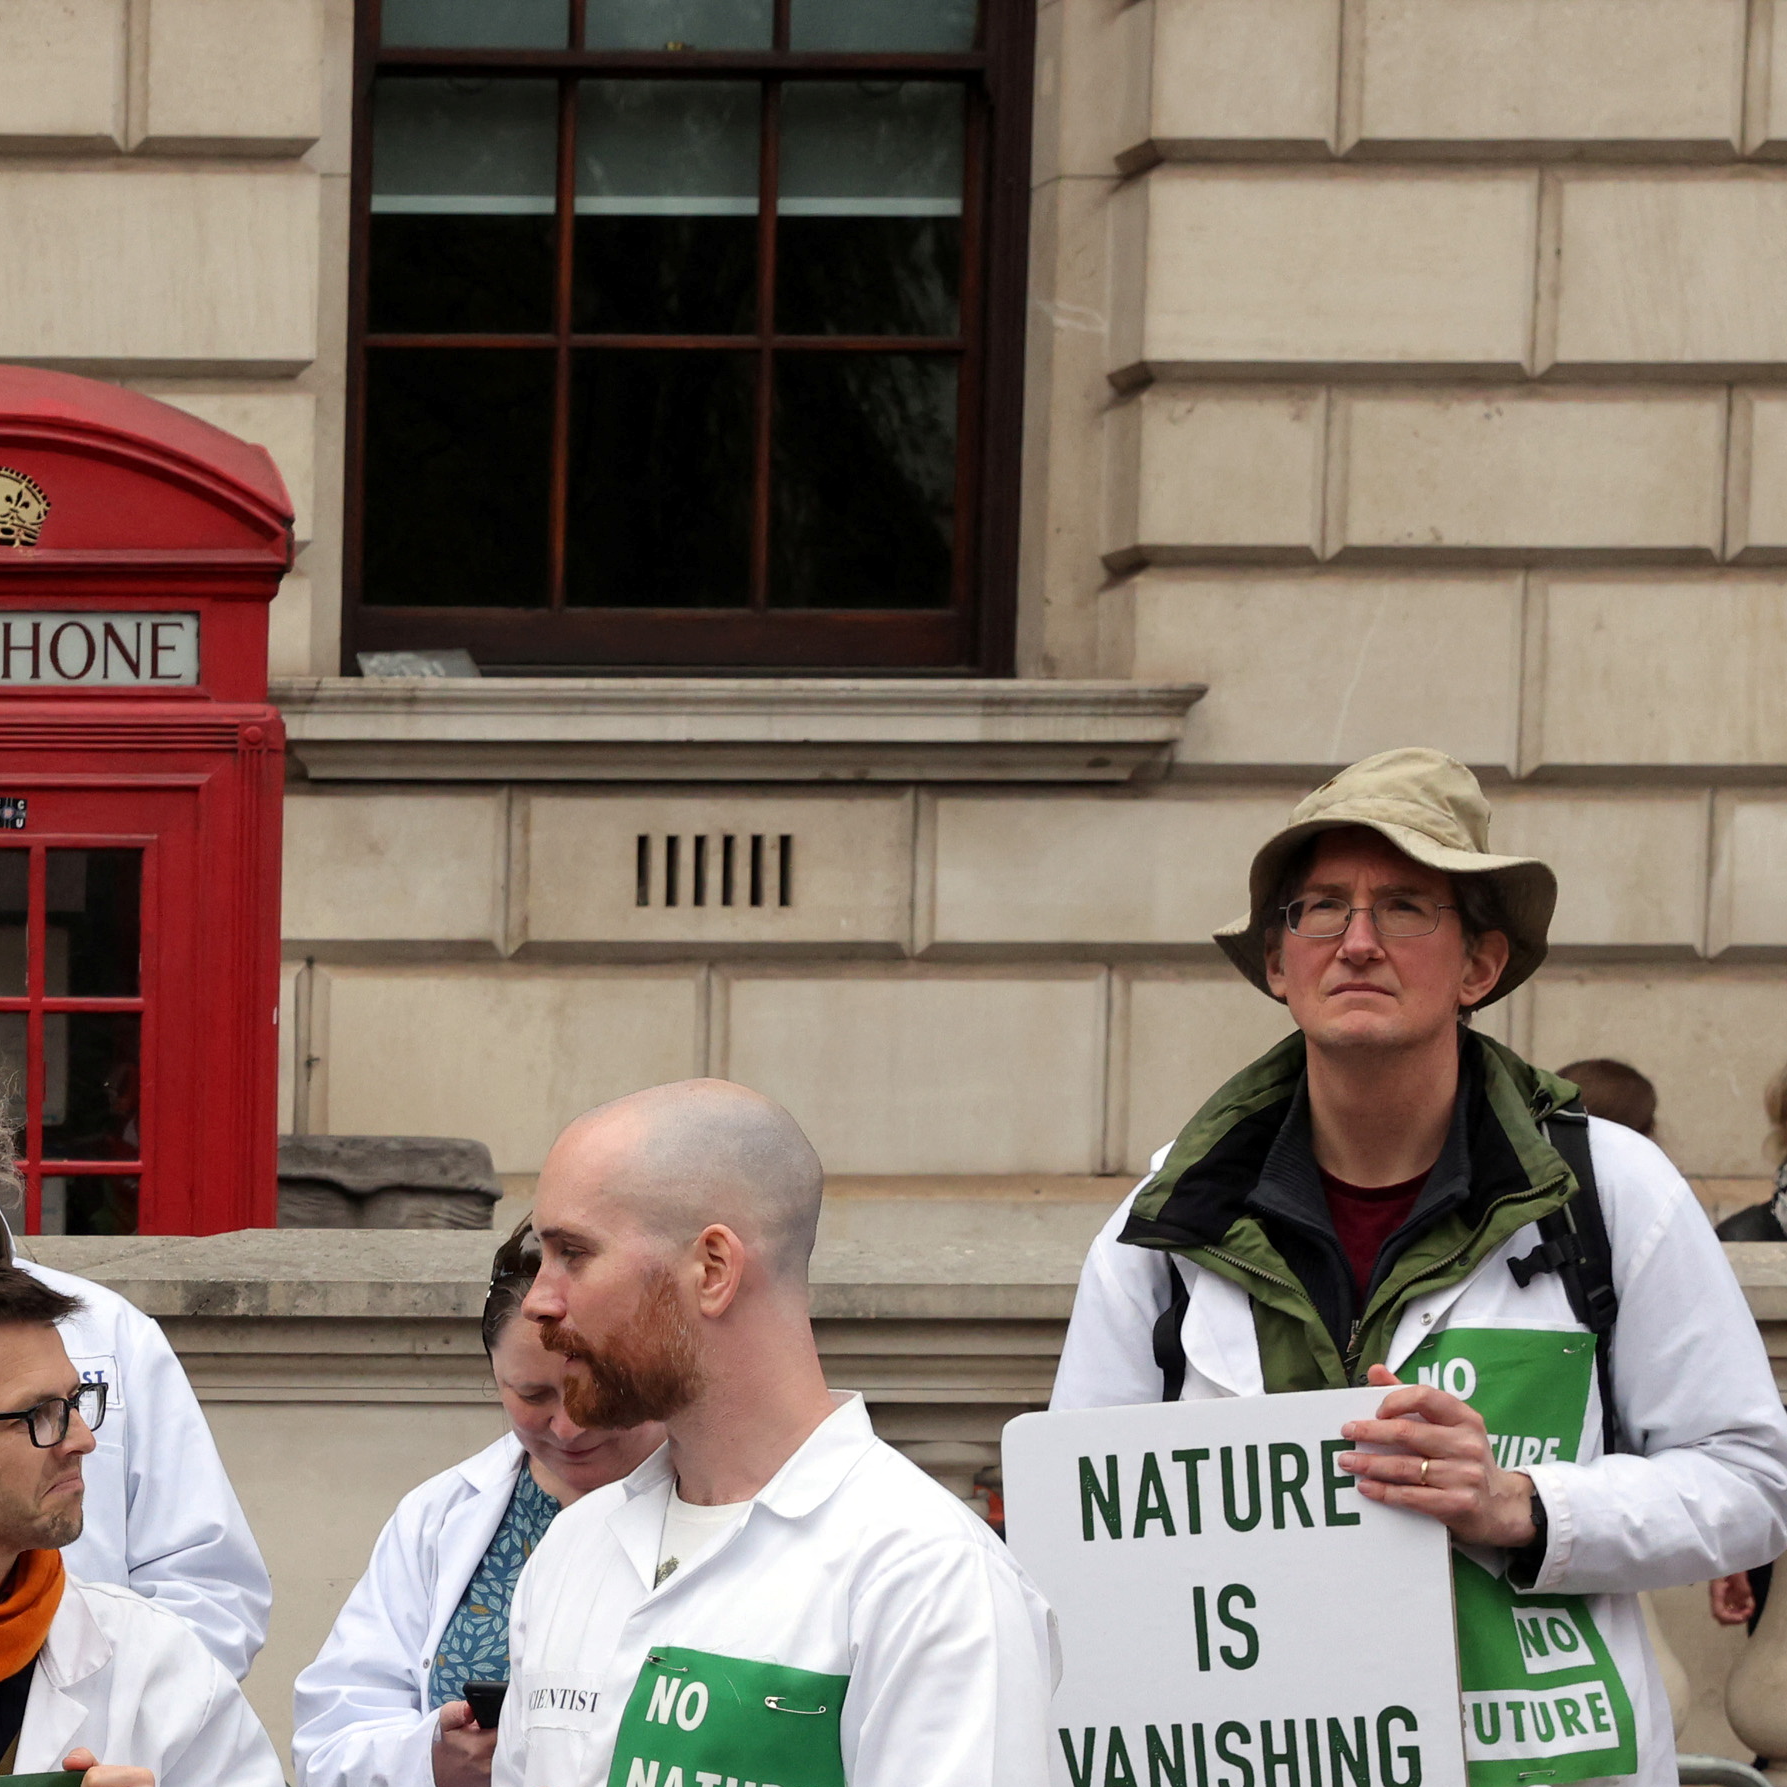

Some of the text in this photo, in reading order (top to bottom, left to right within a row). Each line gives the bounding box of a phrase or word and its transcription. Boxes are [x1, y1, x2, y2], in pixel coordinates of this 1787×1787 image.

[1077, 1440, 1361, 1541] NATURE
[1193, 1584, 1259, 1671] IS
[1517, 1617, 1578, 1658] NO
[646, 1675, 708, 1731] NO
[1462, 1692, 1612, 1745] UTURE
